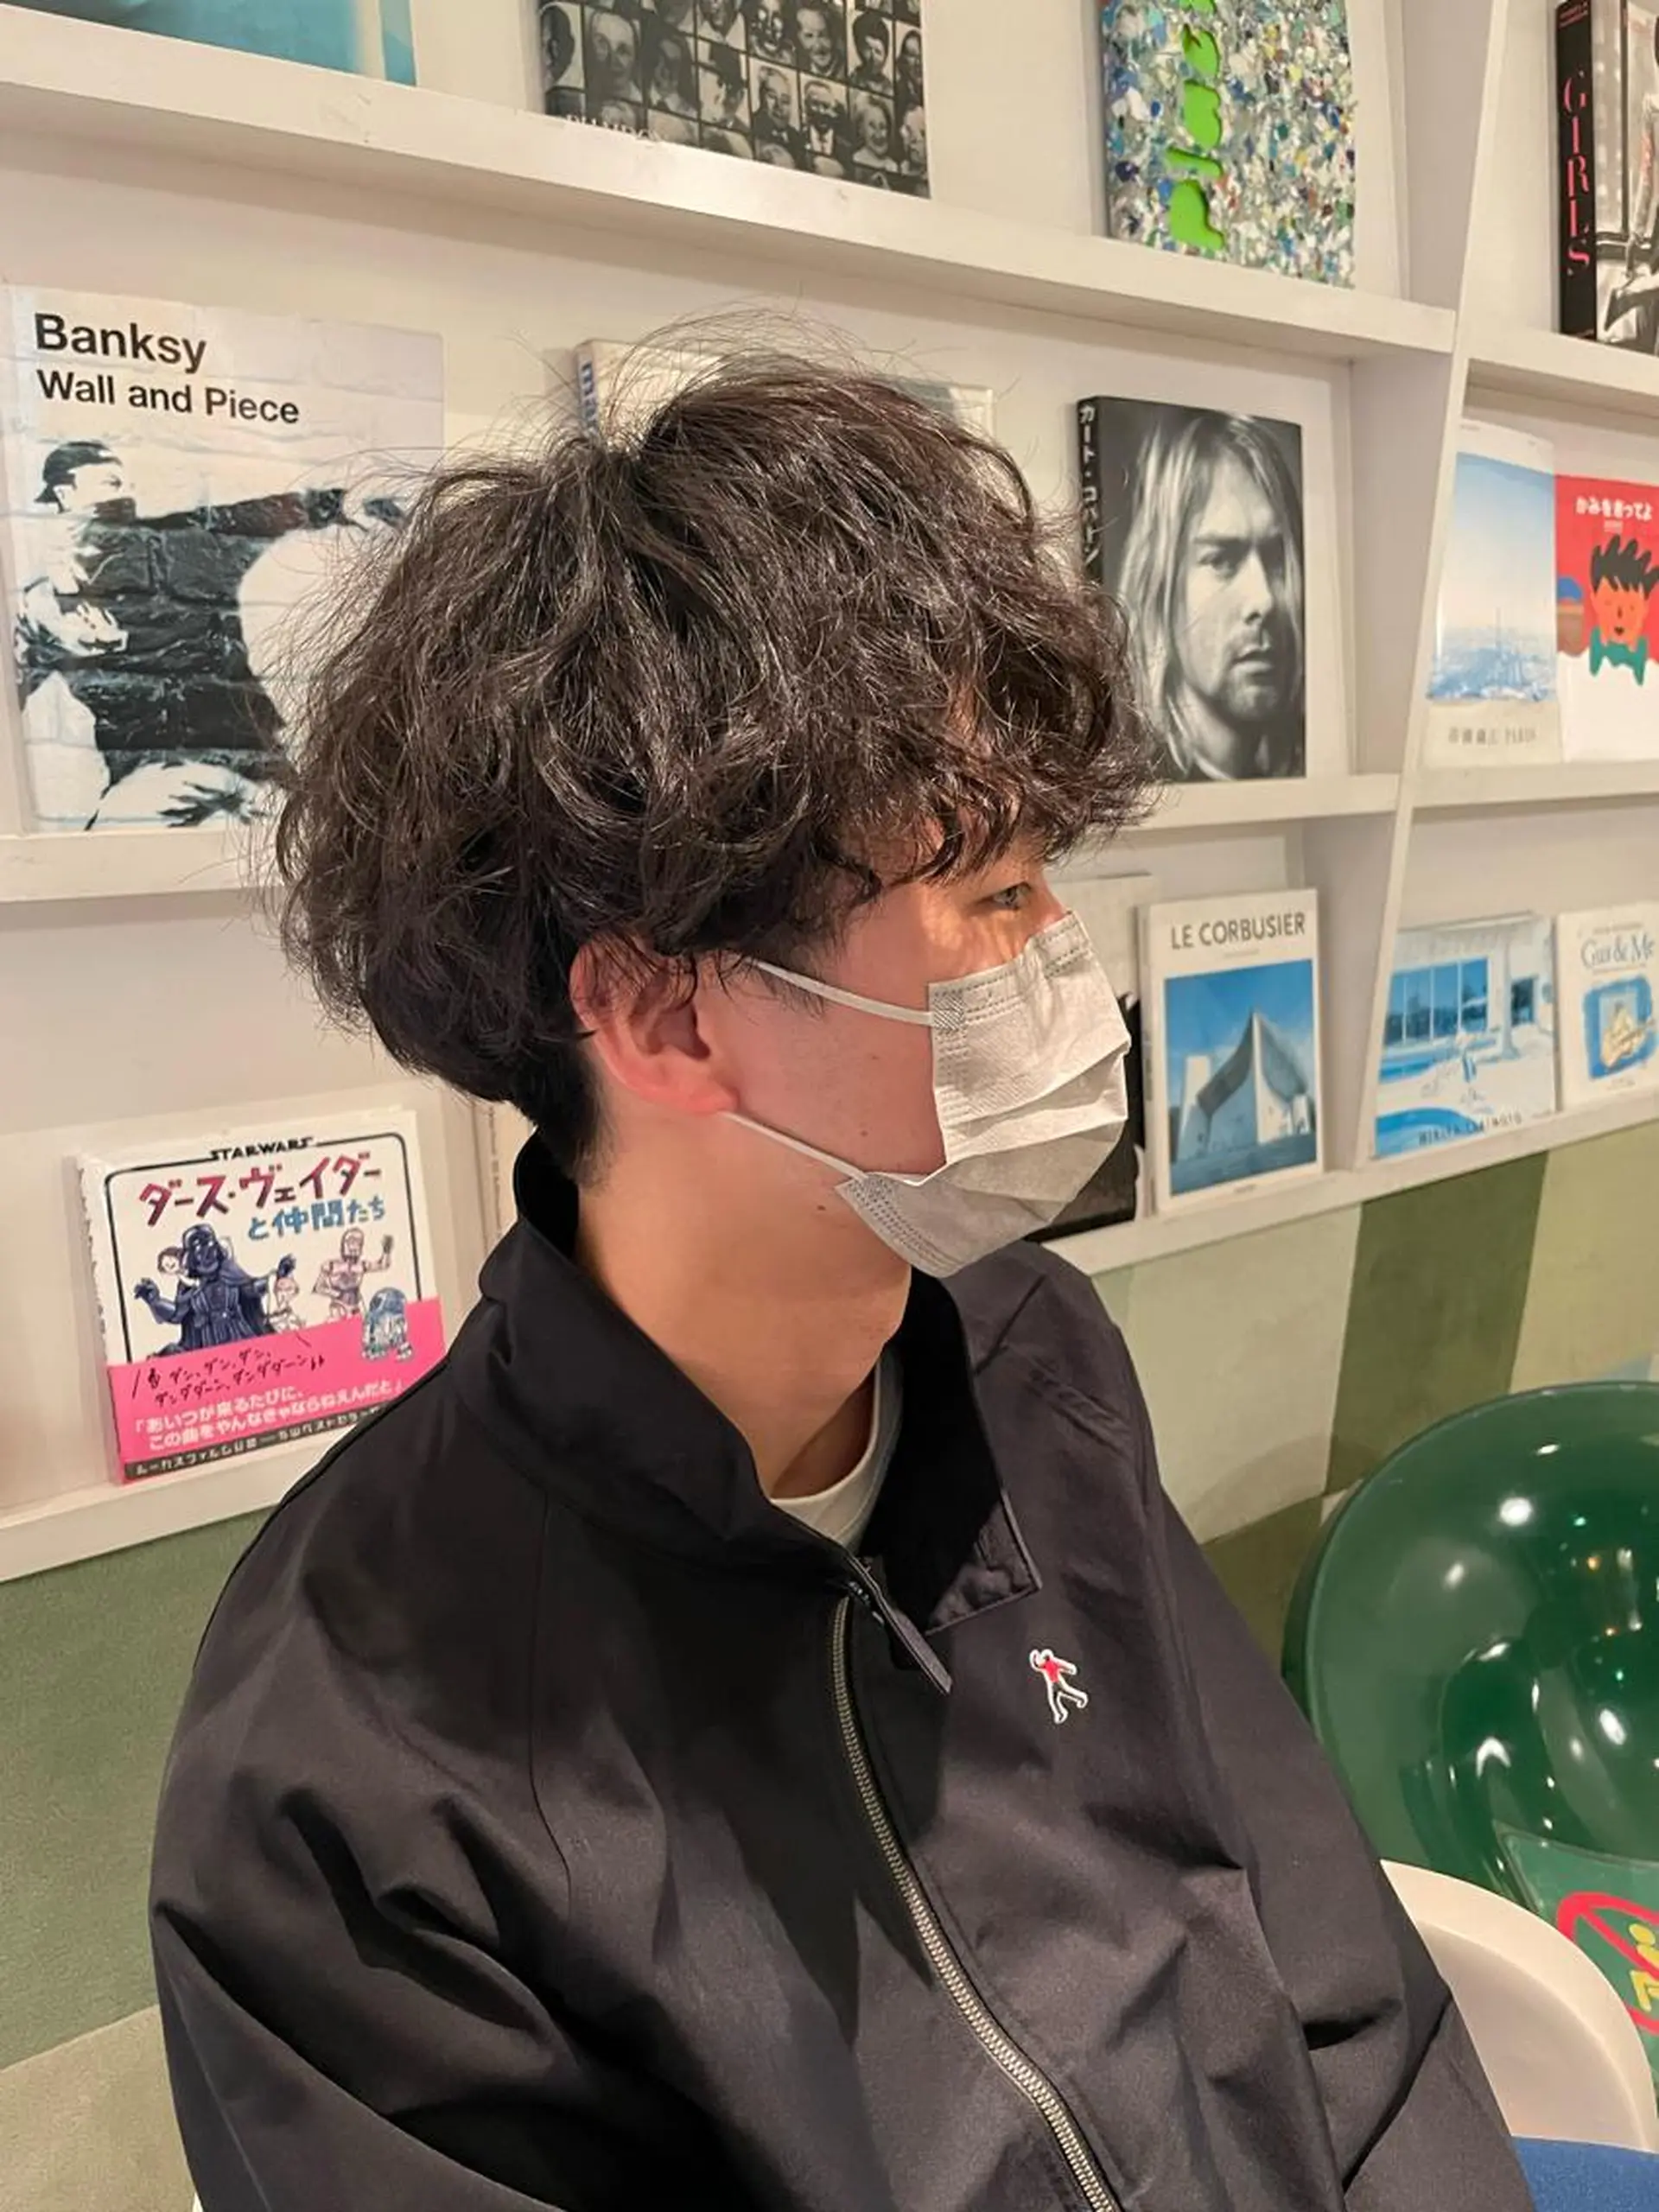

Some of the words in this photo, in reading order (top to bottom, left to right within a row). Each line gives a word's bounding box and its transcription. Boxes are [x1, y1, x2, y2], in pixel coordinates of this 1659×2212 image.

[1562, 68, 1590, 276] GIRLS
[35, 313, 207, 374] Banksy
[37, 369, 115, 405] Wall
[129, 385, 192, 414] and
[206, 388, 300, 423] Piece
[1171, 925, 1194, 950] LE
[1198, 912, 1306, 947] CORBUSIER
[248, 1195, 385, 1241] と仲間たち
